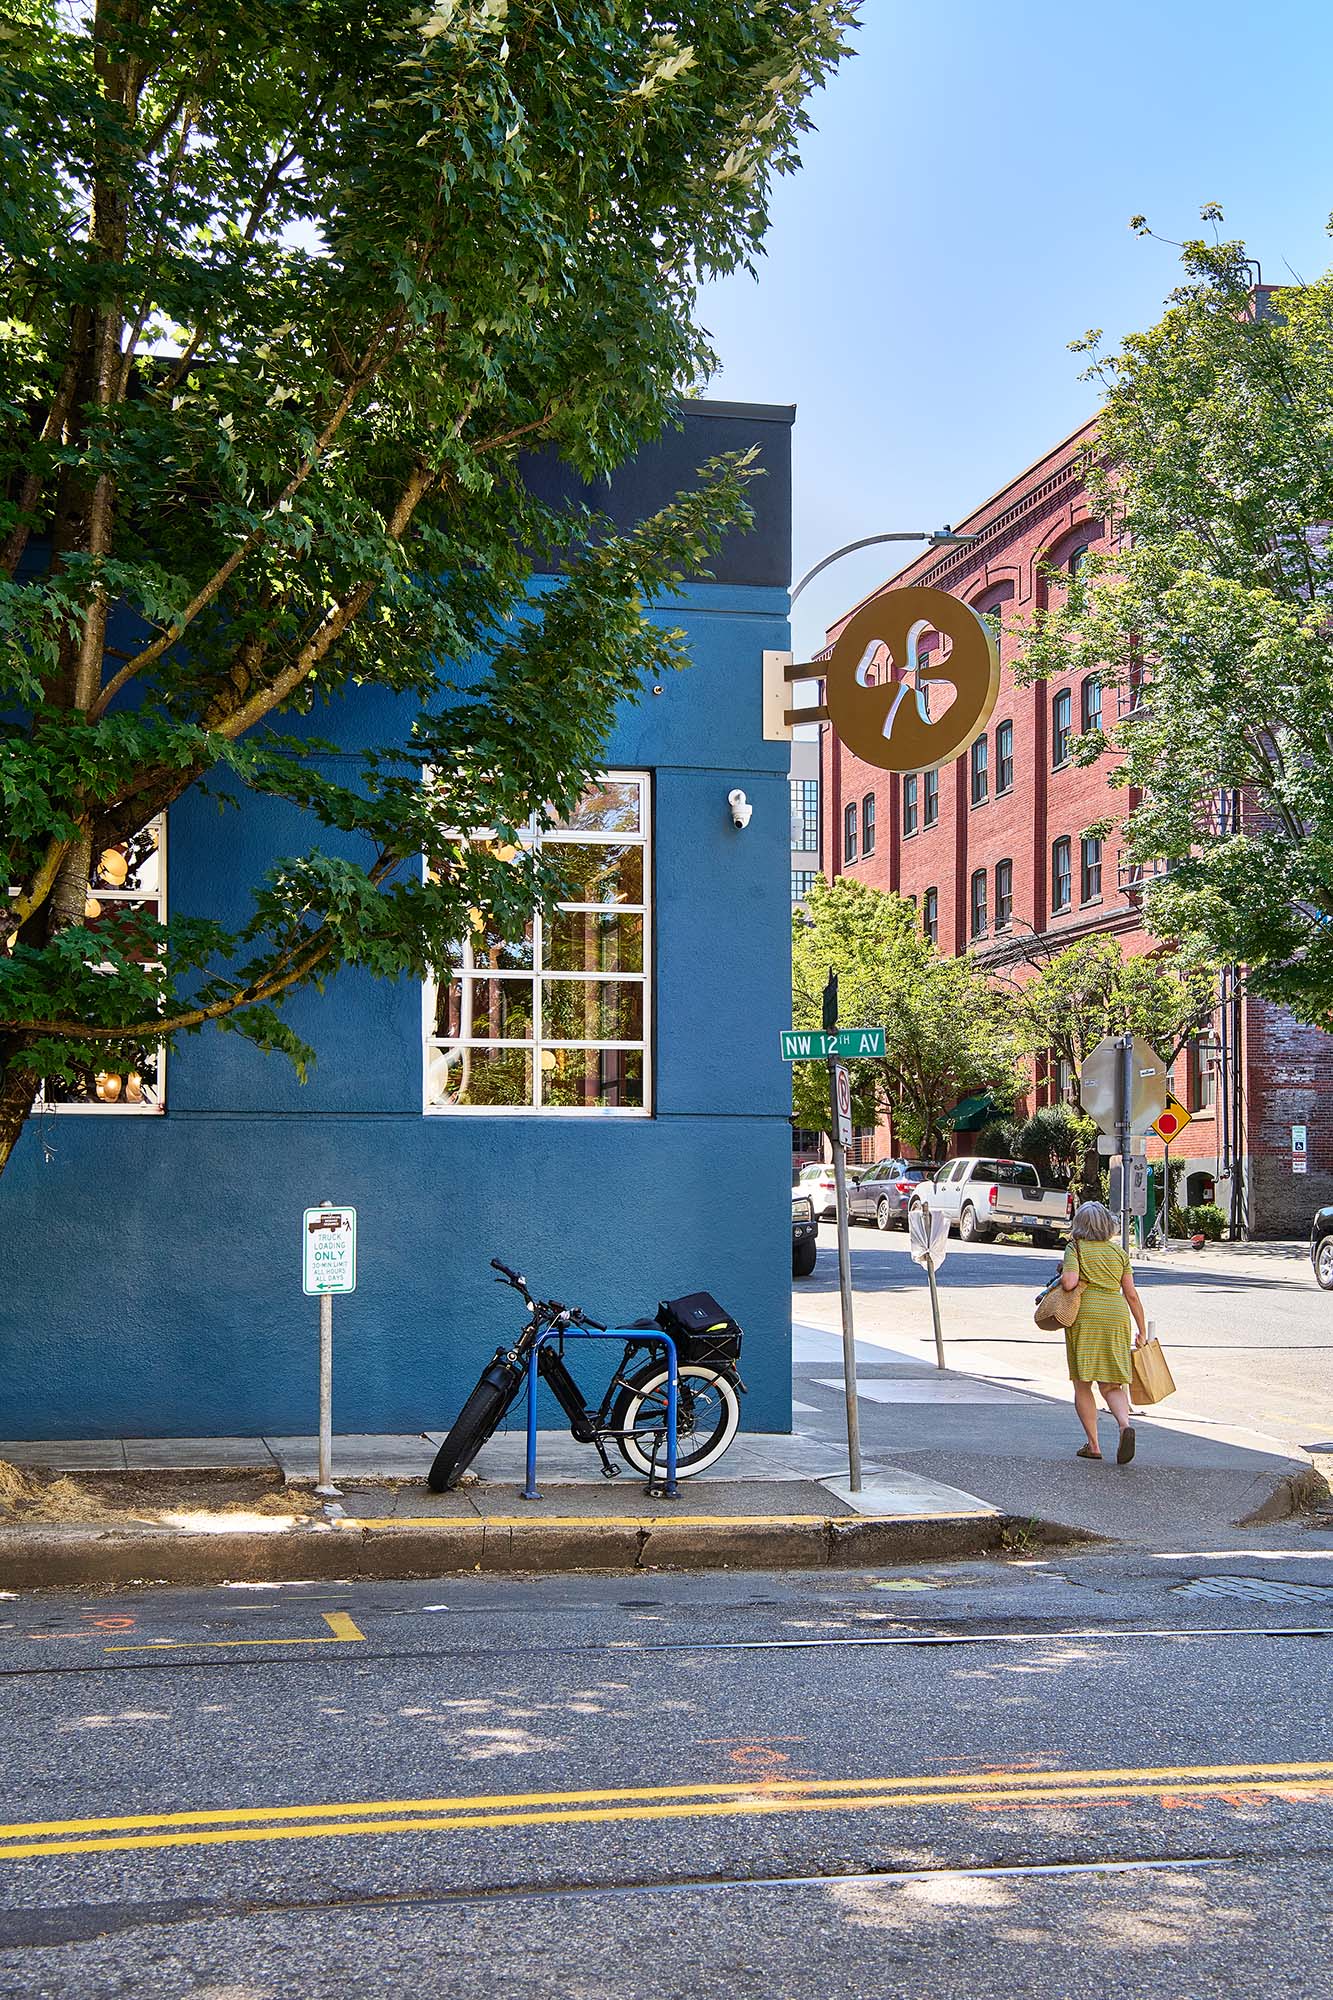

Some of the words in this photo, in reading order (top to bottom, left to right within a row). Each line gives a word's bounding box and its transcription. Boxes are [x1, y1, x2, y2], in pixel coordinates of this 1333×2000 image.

[786, 1035, 811, 1056] NW
[820, 1034, 850, 1054] 12TH
[859, 1033, 879, 1053] AV
[318, 1233, 342, 1241] TRUCK
[313, 1242, 346, 1250] LOADING
[314, 1250, 345, 1261] ONLY
